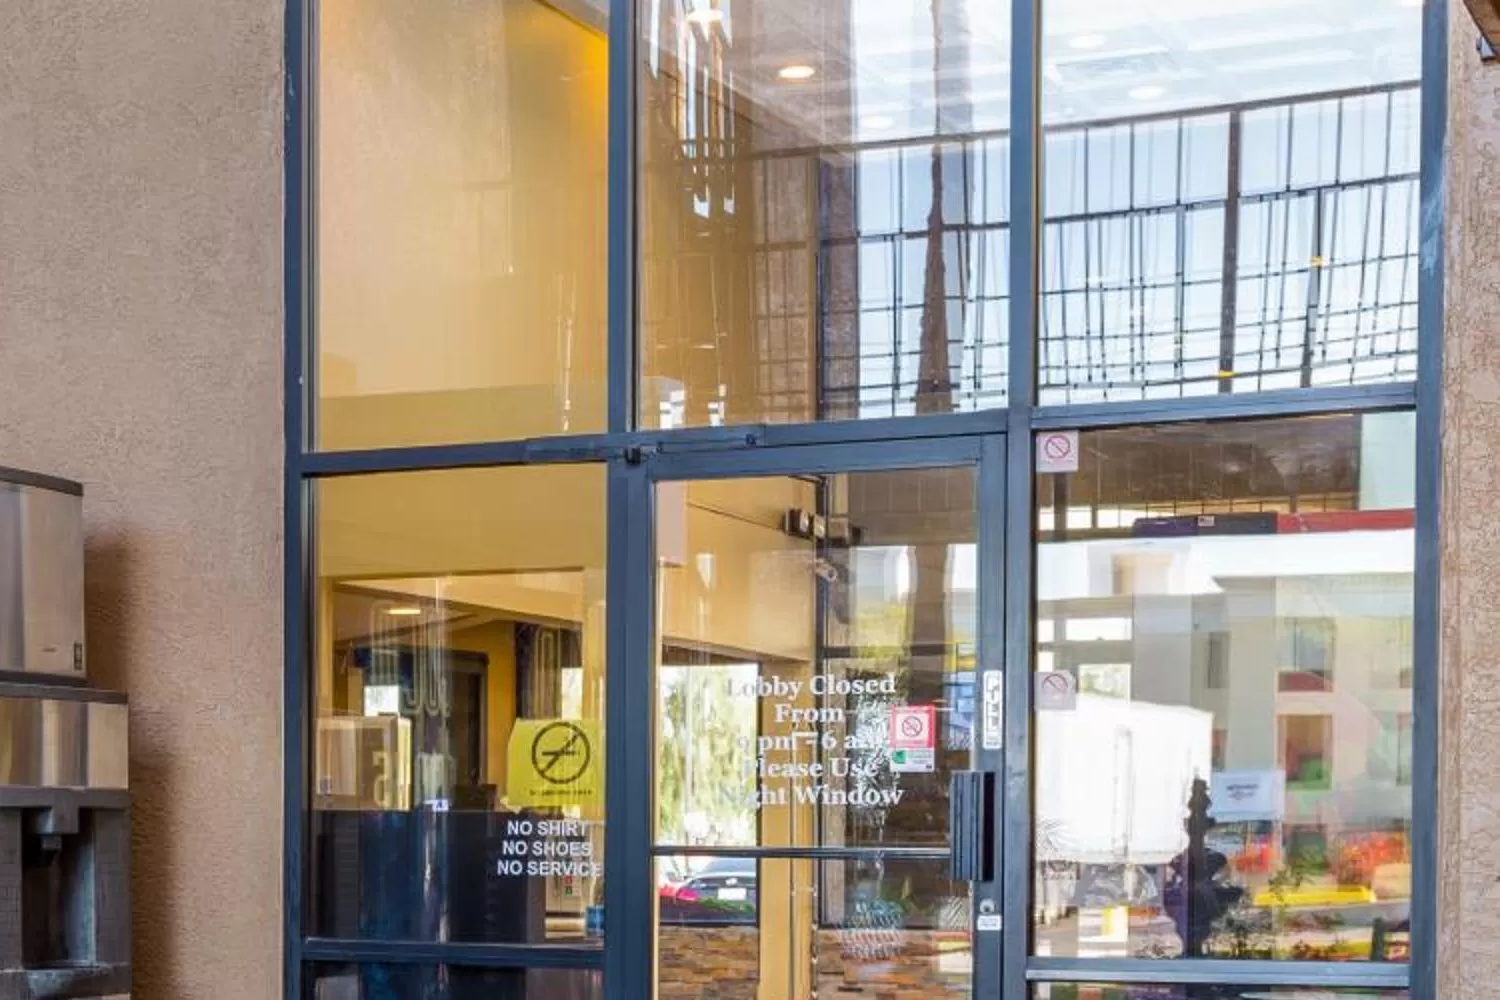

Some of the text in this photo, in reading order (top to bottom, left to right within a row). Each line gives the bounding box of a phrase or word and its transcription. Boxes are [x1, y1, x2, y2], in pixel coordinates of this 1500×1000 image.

[728, 672, 896, 699] Lobby Closed
[774, 704, 844, 723] From
[757, 736, 797, 756] pm
[821, 730, 837, 749] 6
[742, 756, 879, 778] Please Use
[720, 785, 905, 808] Night Window
[507, 820, 587, 836] NO SHIRT
[502, 841, 593, 857] NO SHOES
[497, 861, 603, 877] NO SERVICE
